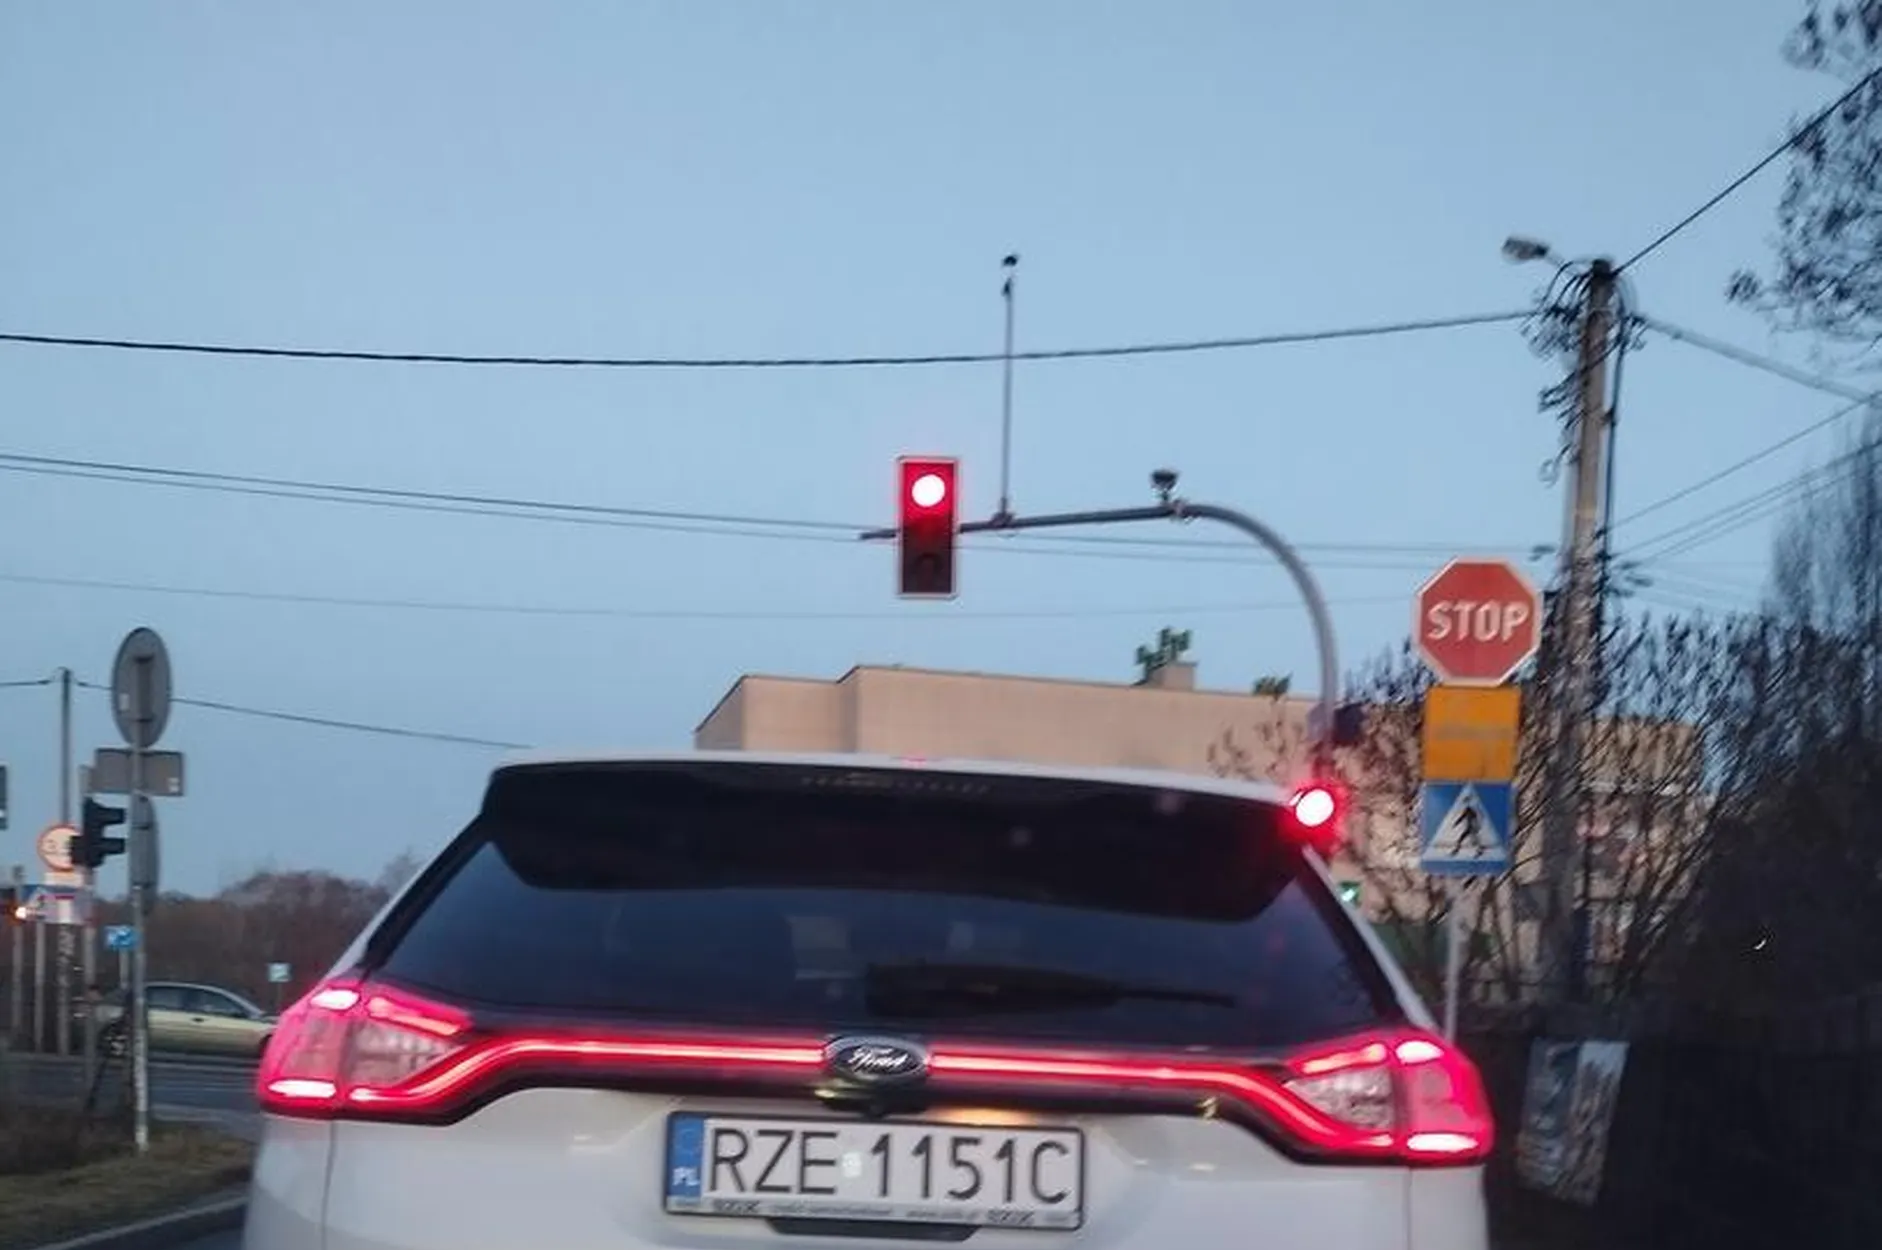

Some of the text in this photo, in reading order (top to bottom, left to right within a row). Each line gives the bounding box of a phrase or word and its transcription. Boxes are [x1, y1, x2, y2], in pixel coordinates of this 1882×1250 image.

[1427, 600, 1529, 642] STOP
[848, 1046, 908, 1072] Ford
[709, 1127, 1071, 1205] RZE 1151C
